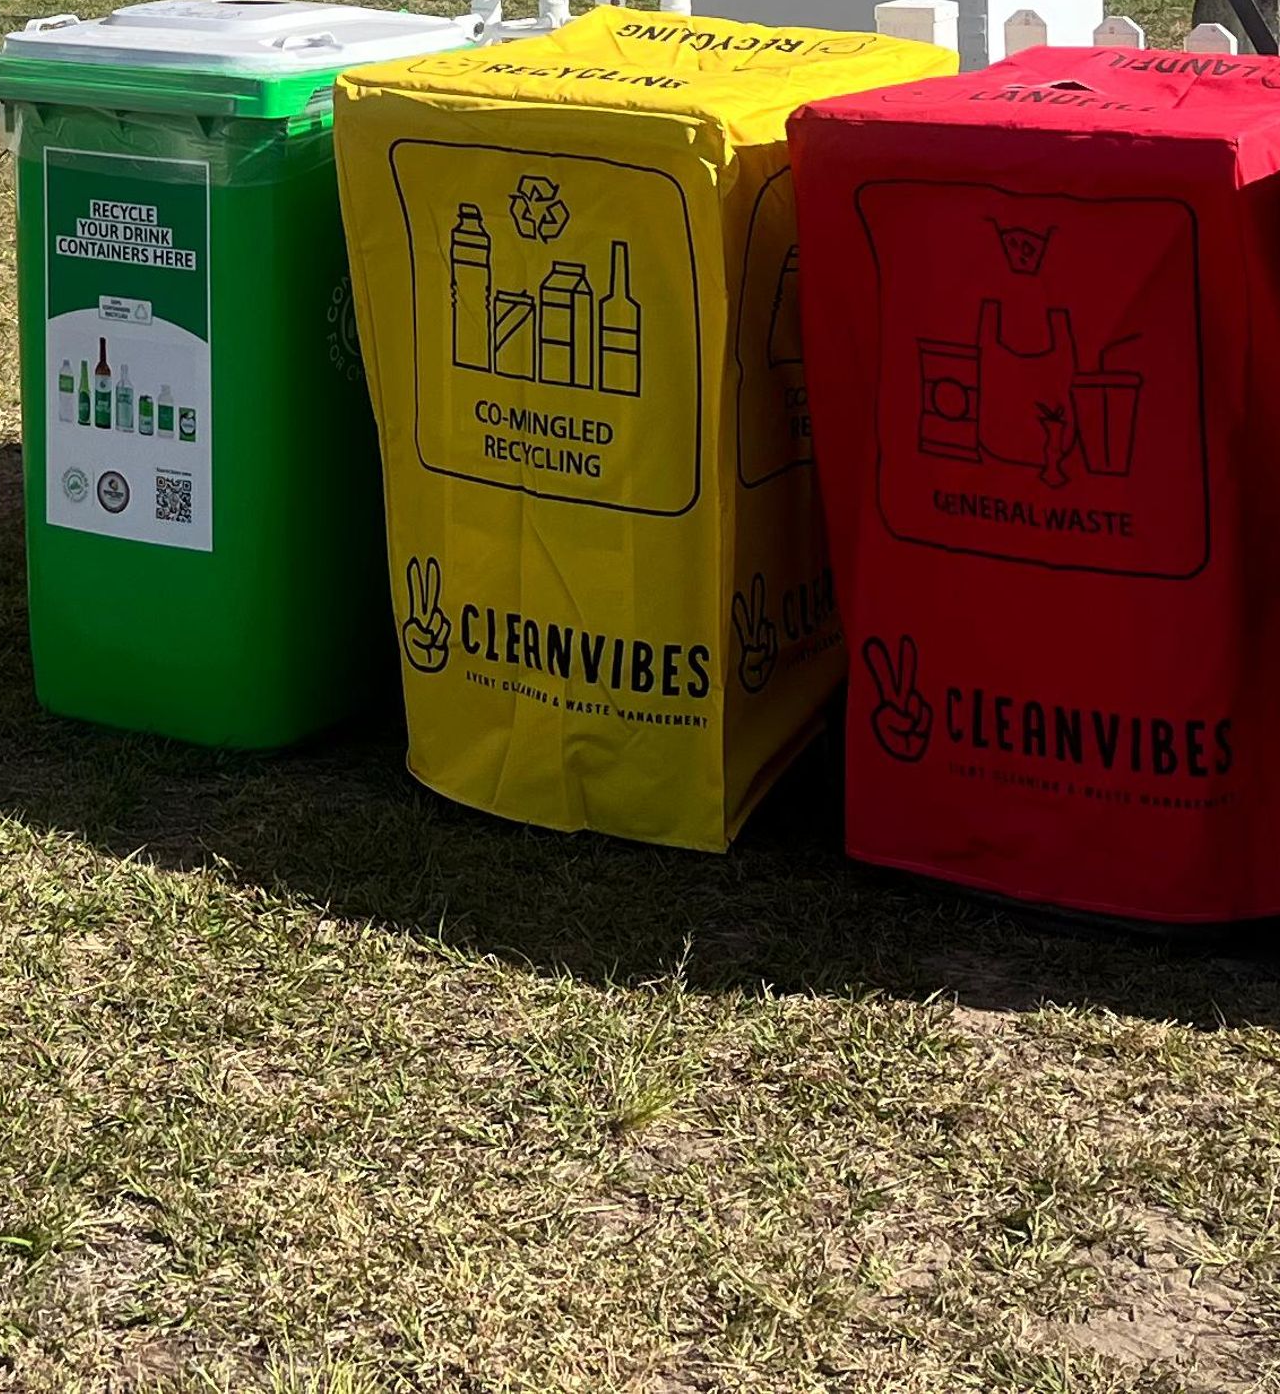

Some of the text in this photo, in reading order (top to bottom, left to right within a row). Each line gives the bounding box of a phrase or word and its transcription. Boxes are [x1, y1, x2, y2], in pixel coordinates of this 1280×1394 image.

[482, 63, 690, 89] RECYCLNG
[92, 201, 155, 224] RECYCLE
[78, 219, 171, 246] YOUR DRINK
[58, 238, 194, 269] CONTAINERS HERE
[474, 399, 614, 446] CO-MINGLED
[483, 435, 602, 479] RECYCLING
[932, 489, 1135, 538] GENERAL WASTE
[460, 603, 711, 700] CLEANVIBES
[502, 681, 548, 704] CLEANING
[566, 700, 610, 716] WASTE
[945, 686, 1235, 777] CLEANVIBES
